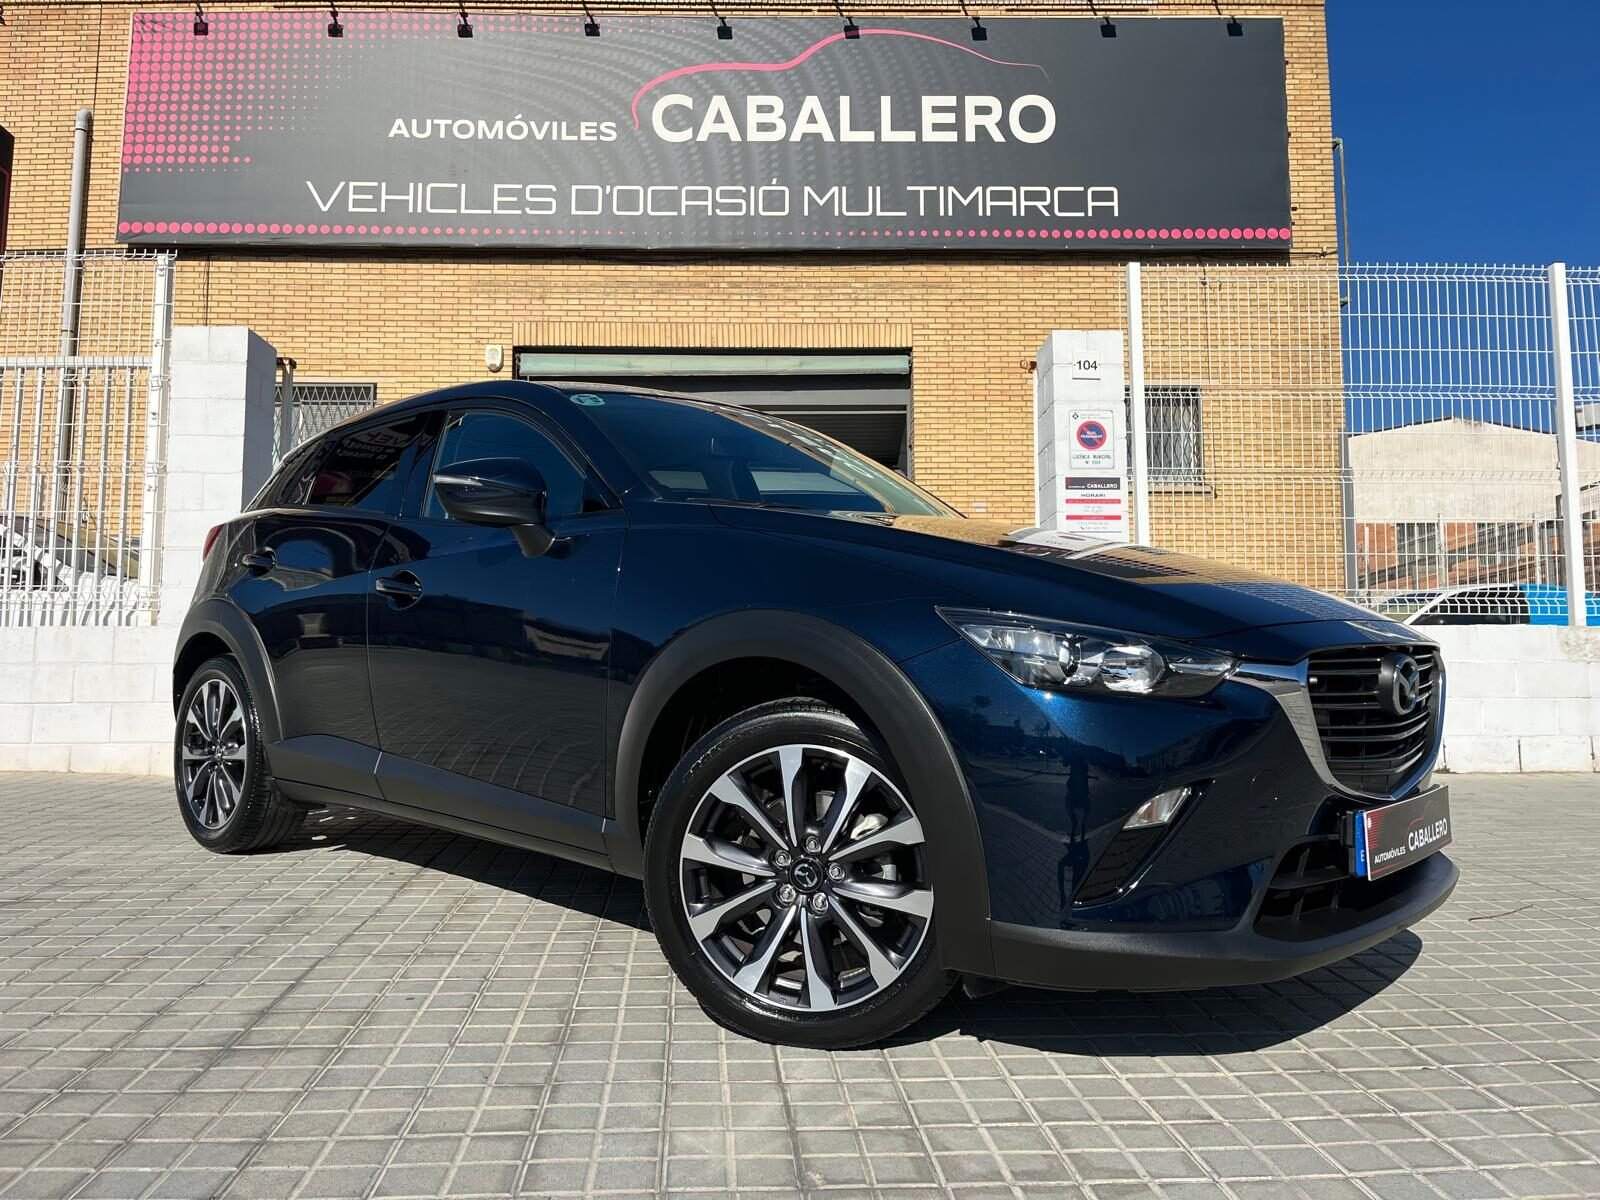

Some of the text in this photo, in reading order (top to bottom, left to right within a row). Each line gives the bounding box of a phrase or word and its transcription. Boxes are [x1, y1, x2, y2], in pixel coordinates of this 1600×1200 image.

[388, 93, 1056, 143] AUTOMÓVILES CABALLERO
[305, 178, 1119, 217] VEHICLES D'OCASIÓ MULTIMARCA
[1076, 359, 1098, 371] 104
[1374, 817, 1448, 864] AUTOMÓVILES CABALLERO
